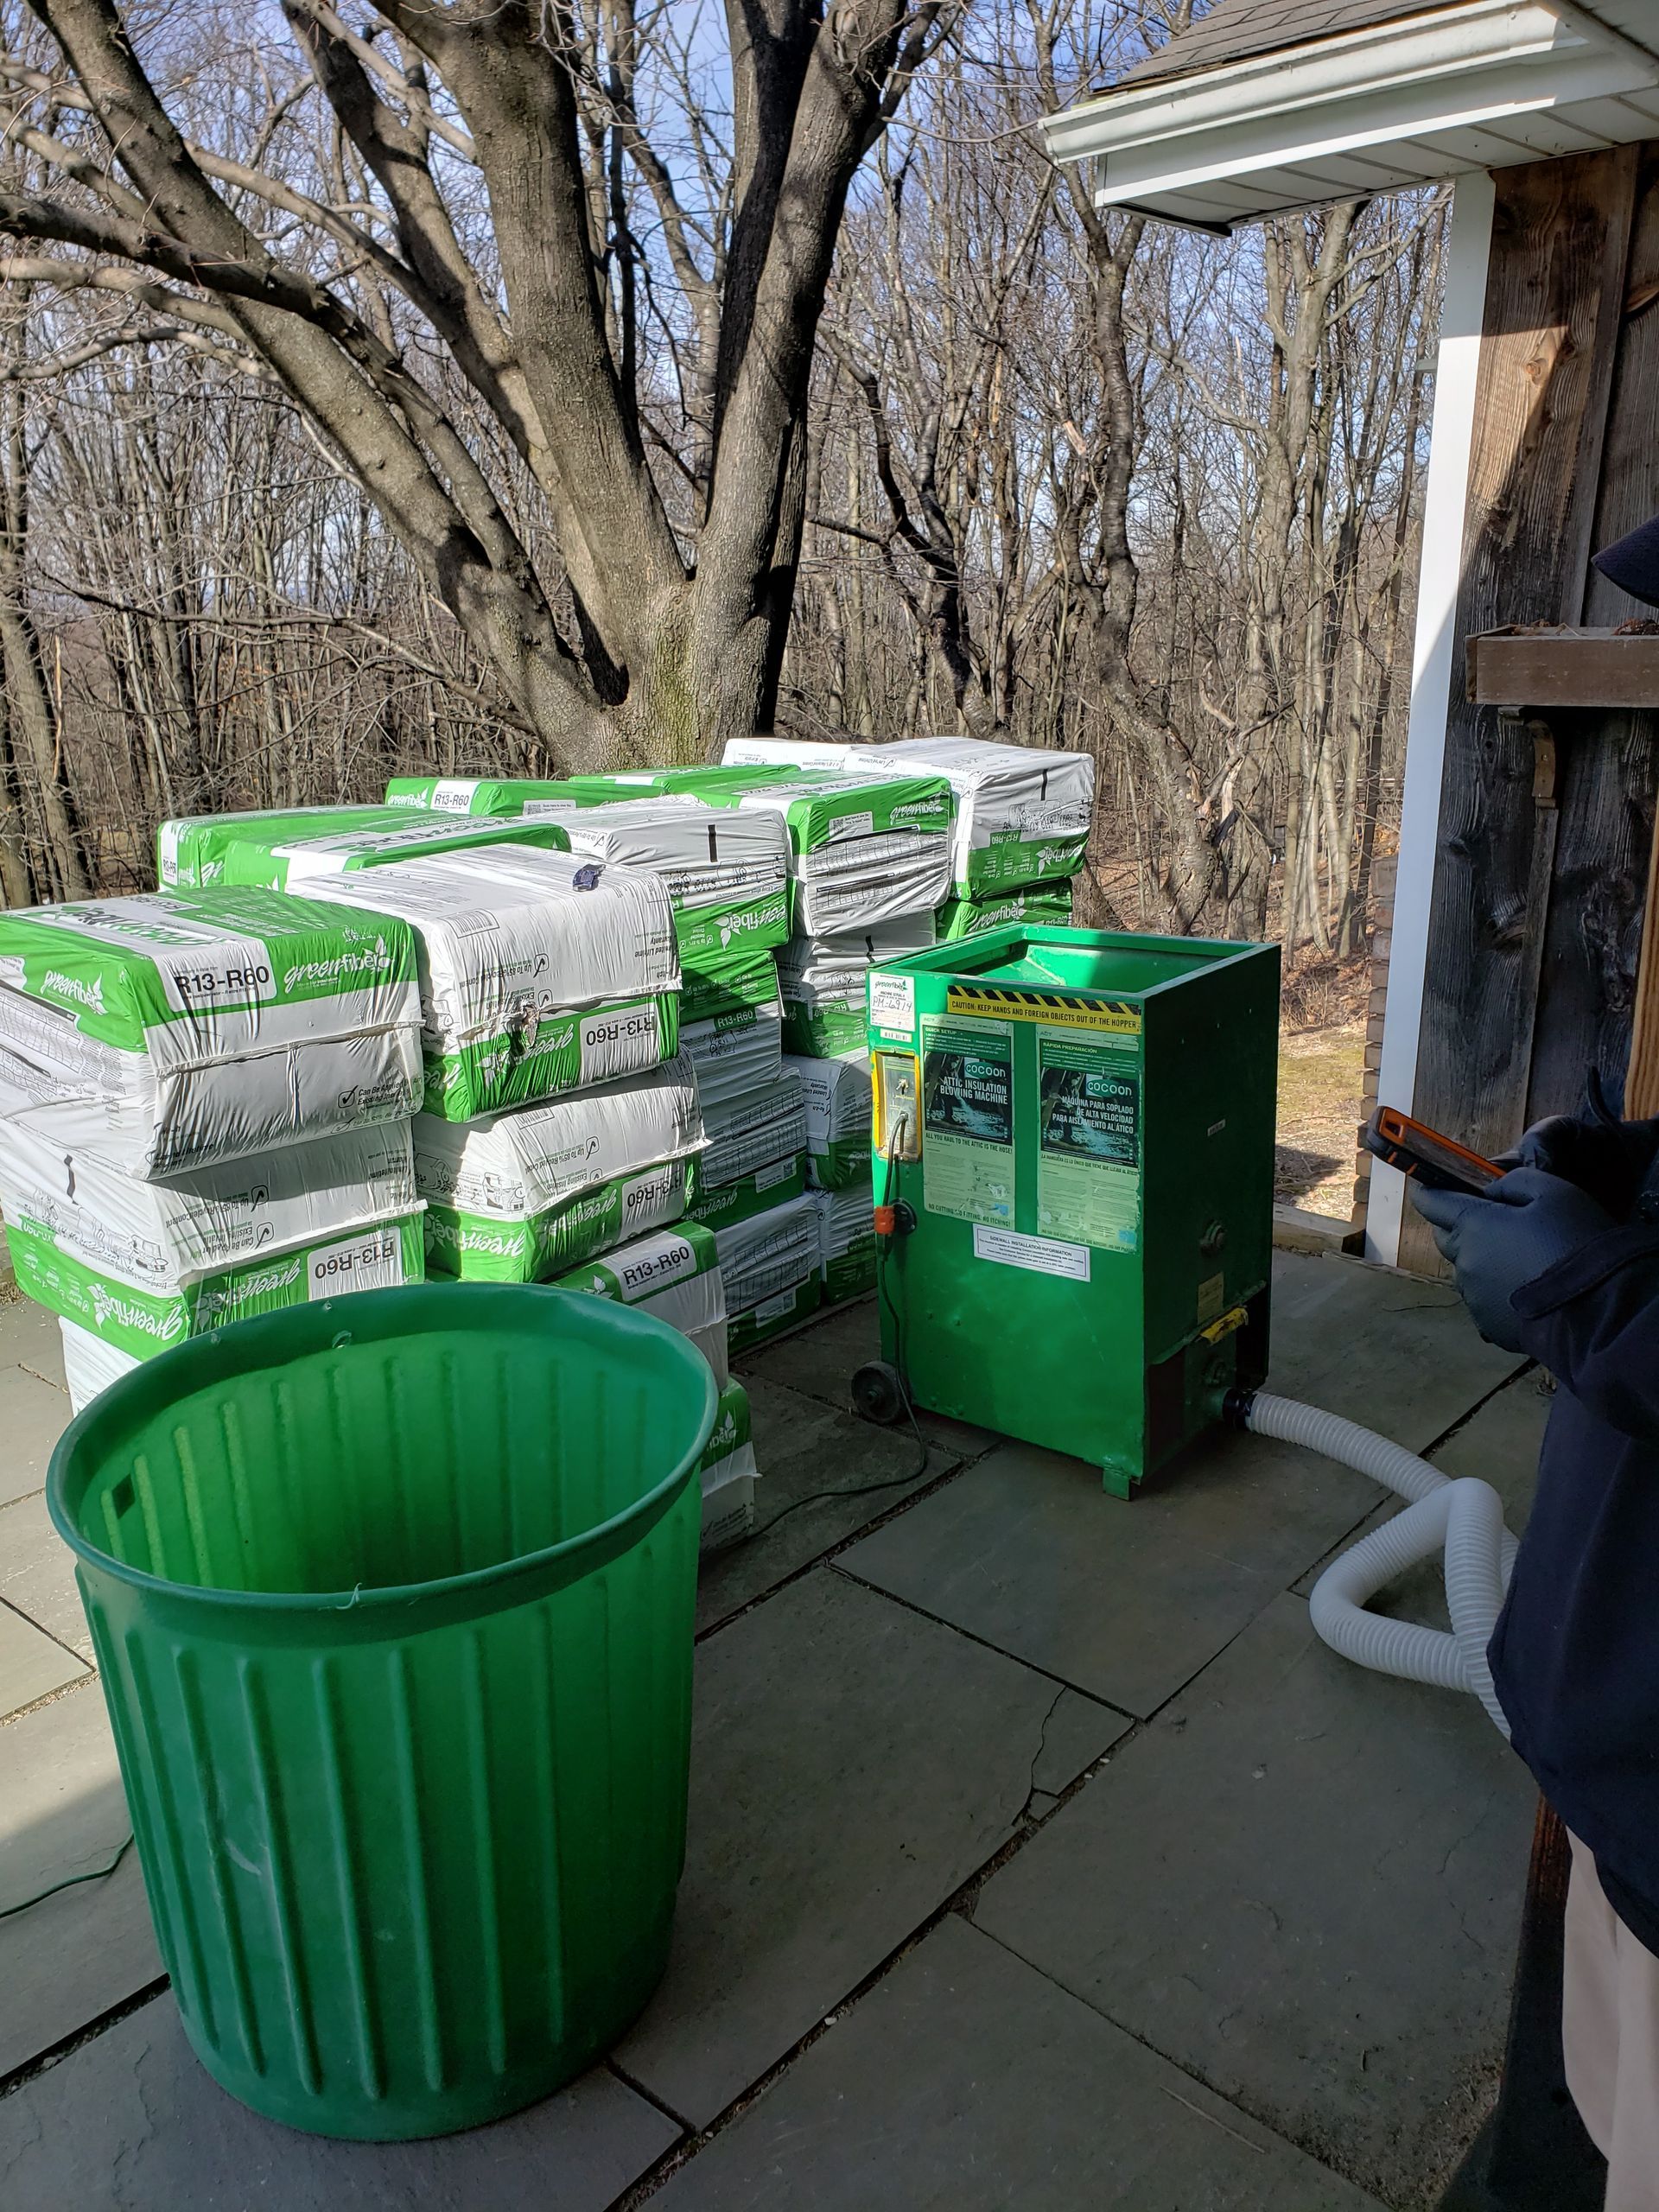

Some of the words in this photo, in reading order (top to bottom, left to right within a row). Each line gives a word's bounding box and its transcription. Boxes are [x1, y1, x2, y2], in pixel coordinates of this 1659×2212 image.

[434, 792, 470, 807] R13-R60
[890, 801, 938, 826] greenfiber
[992, 834, 1018, 845] R13-R60
[174, 965, 270, 993] R13-R60
[284, 951, 387, 994] greenfiber
[41, 969, 100, 1013] greenfiber
[717, 1010, 753, 1027] R13-R60
[952, 1001, 976, 1009] CAUTION:
[977, 1003, 991, 1012] KEEP
[993, 1005, 1011, 1014] HANDS
[1025, 1009, 1049, 1019] FOREIGN
[1051, 1012, 1075, 1021] OBJECTS
[1111, 1019, 1136, 1028] HOPPER
[586, 1019, 655, 1046] R13-R60
[965, 1065, 1006, 1077] cocoon
[940, 1085, 972, 1098] BLOWING
[975, 1090, 1008, 1104] MACHINE
[944, 1077, 963, 1087] ATTIC
[965, 1079, 1007, 1095] INSULATION
[1089, 1082, 1132, 1096] cocoon
[1062, 1096, 1088, 1107] MÁQUINA
[1090, 1101, 1105, 1110] PARA
[1106, 1103, 1134, 1115] SOPLADO
[1077, 1107, 1084, 1116] DE
[1085, 1109, 1099, 1118] ALTA
[1100, 1111, 1134, 1124] VELOCIDAD
[1052, 1113, 1067, 1122] PARA
[1069, 1116, 1106, 1129] AISLAMIENTO
[971, 1140, 983, 1148] ATTIC
[688, 1186, 739, 1221] greenfiber
[435, 1221, 525, 1259] greenfiber
[990, 1236, 1010, 1244] SIDEWALL
[1011, 1240, 1041, 1250] INSTALLATION
[1042, 1246, 1072, 1256] INFORMATION
[315, 1237, 394, 1280] R13-R60
[621, 1246, 690, 1286] R13-R60
[100, 1292, 183, 1341] greenfiber
